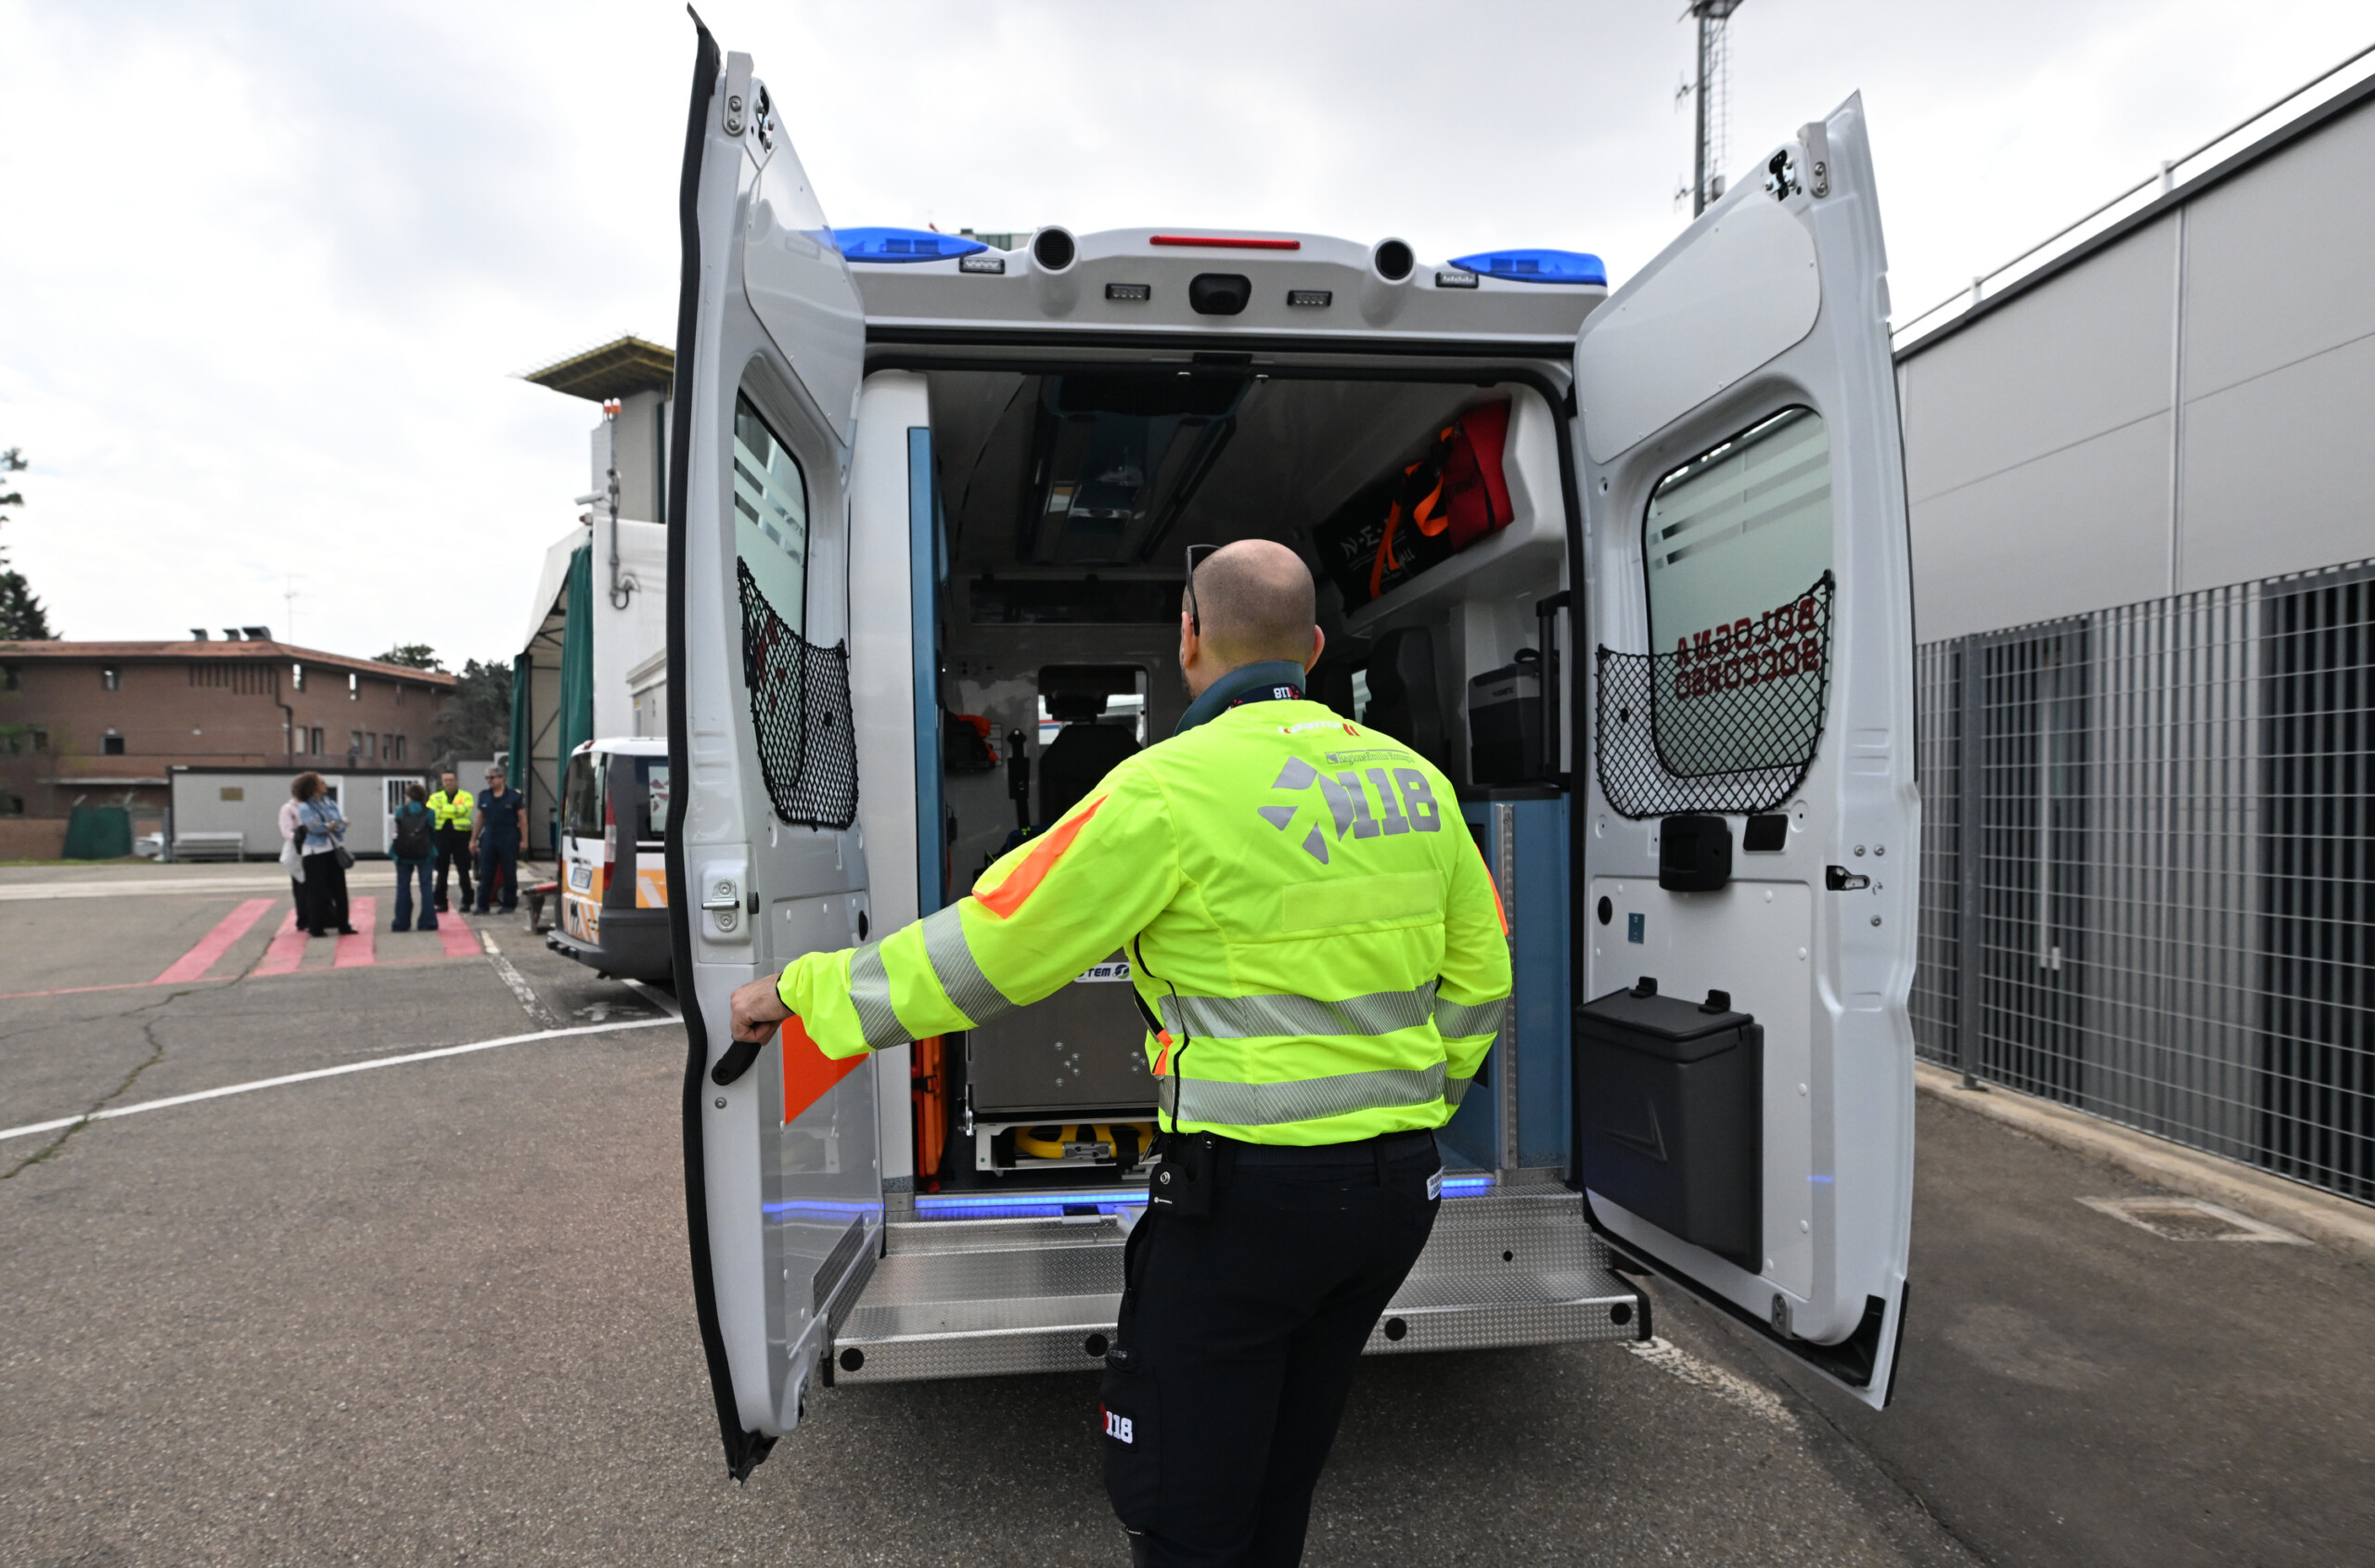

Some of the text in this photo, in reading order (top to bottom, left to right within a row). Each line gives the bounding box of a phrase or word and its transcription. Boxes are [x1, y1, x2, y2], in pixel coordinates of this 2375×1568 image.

[1273, 687, 1291, 700] 118
[1336, 767, 1442, 840] 118
[1106, 1410, 1134, 1445] 118
